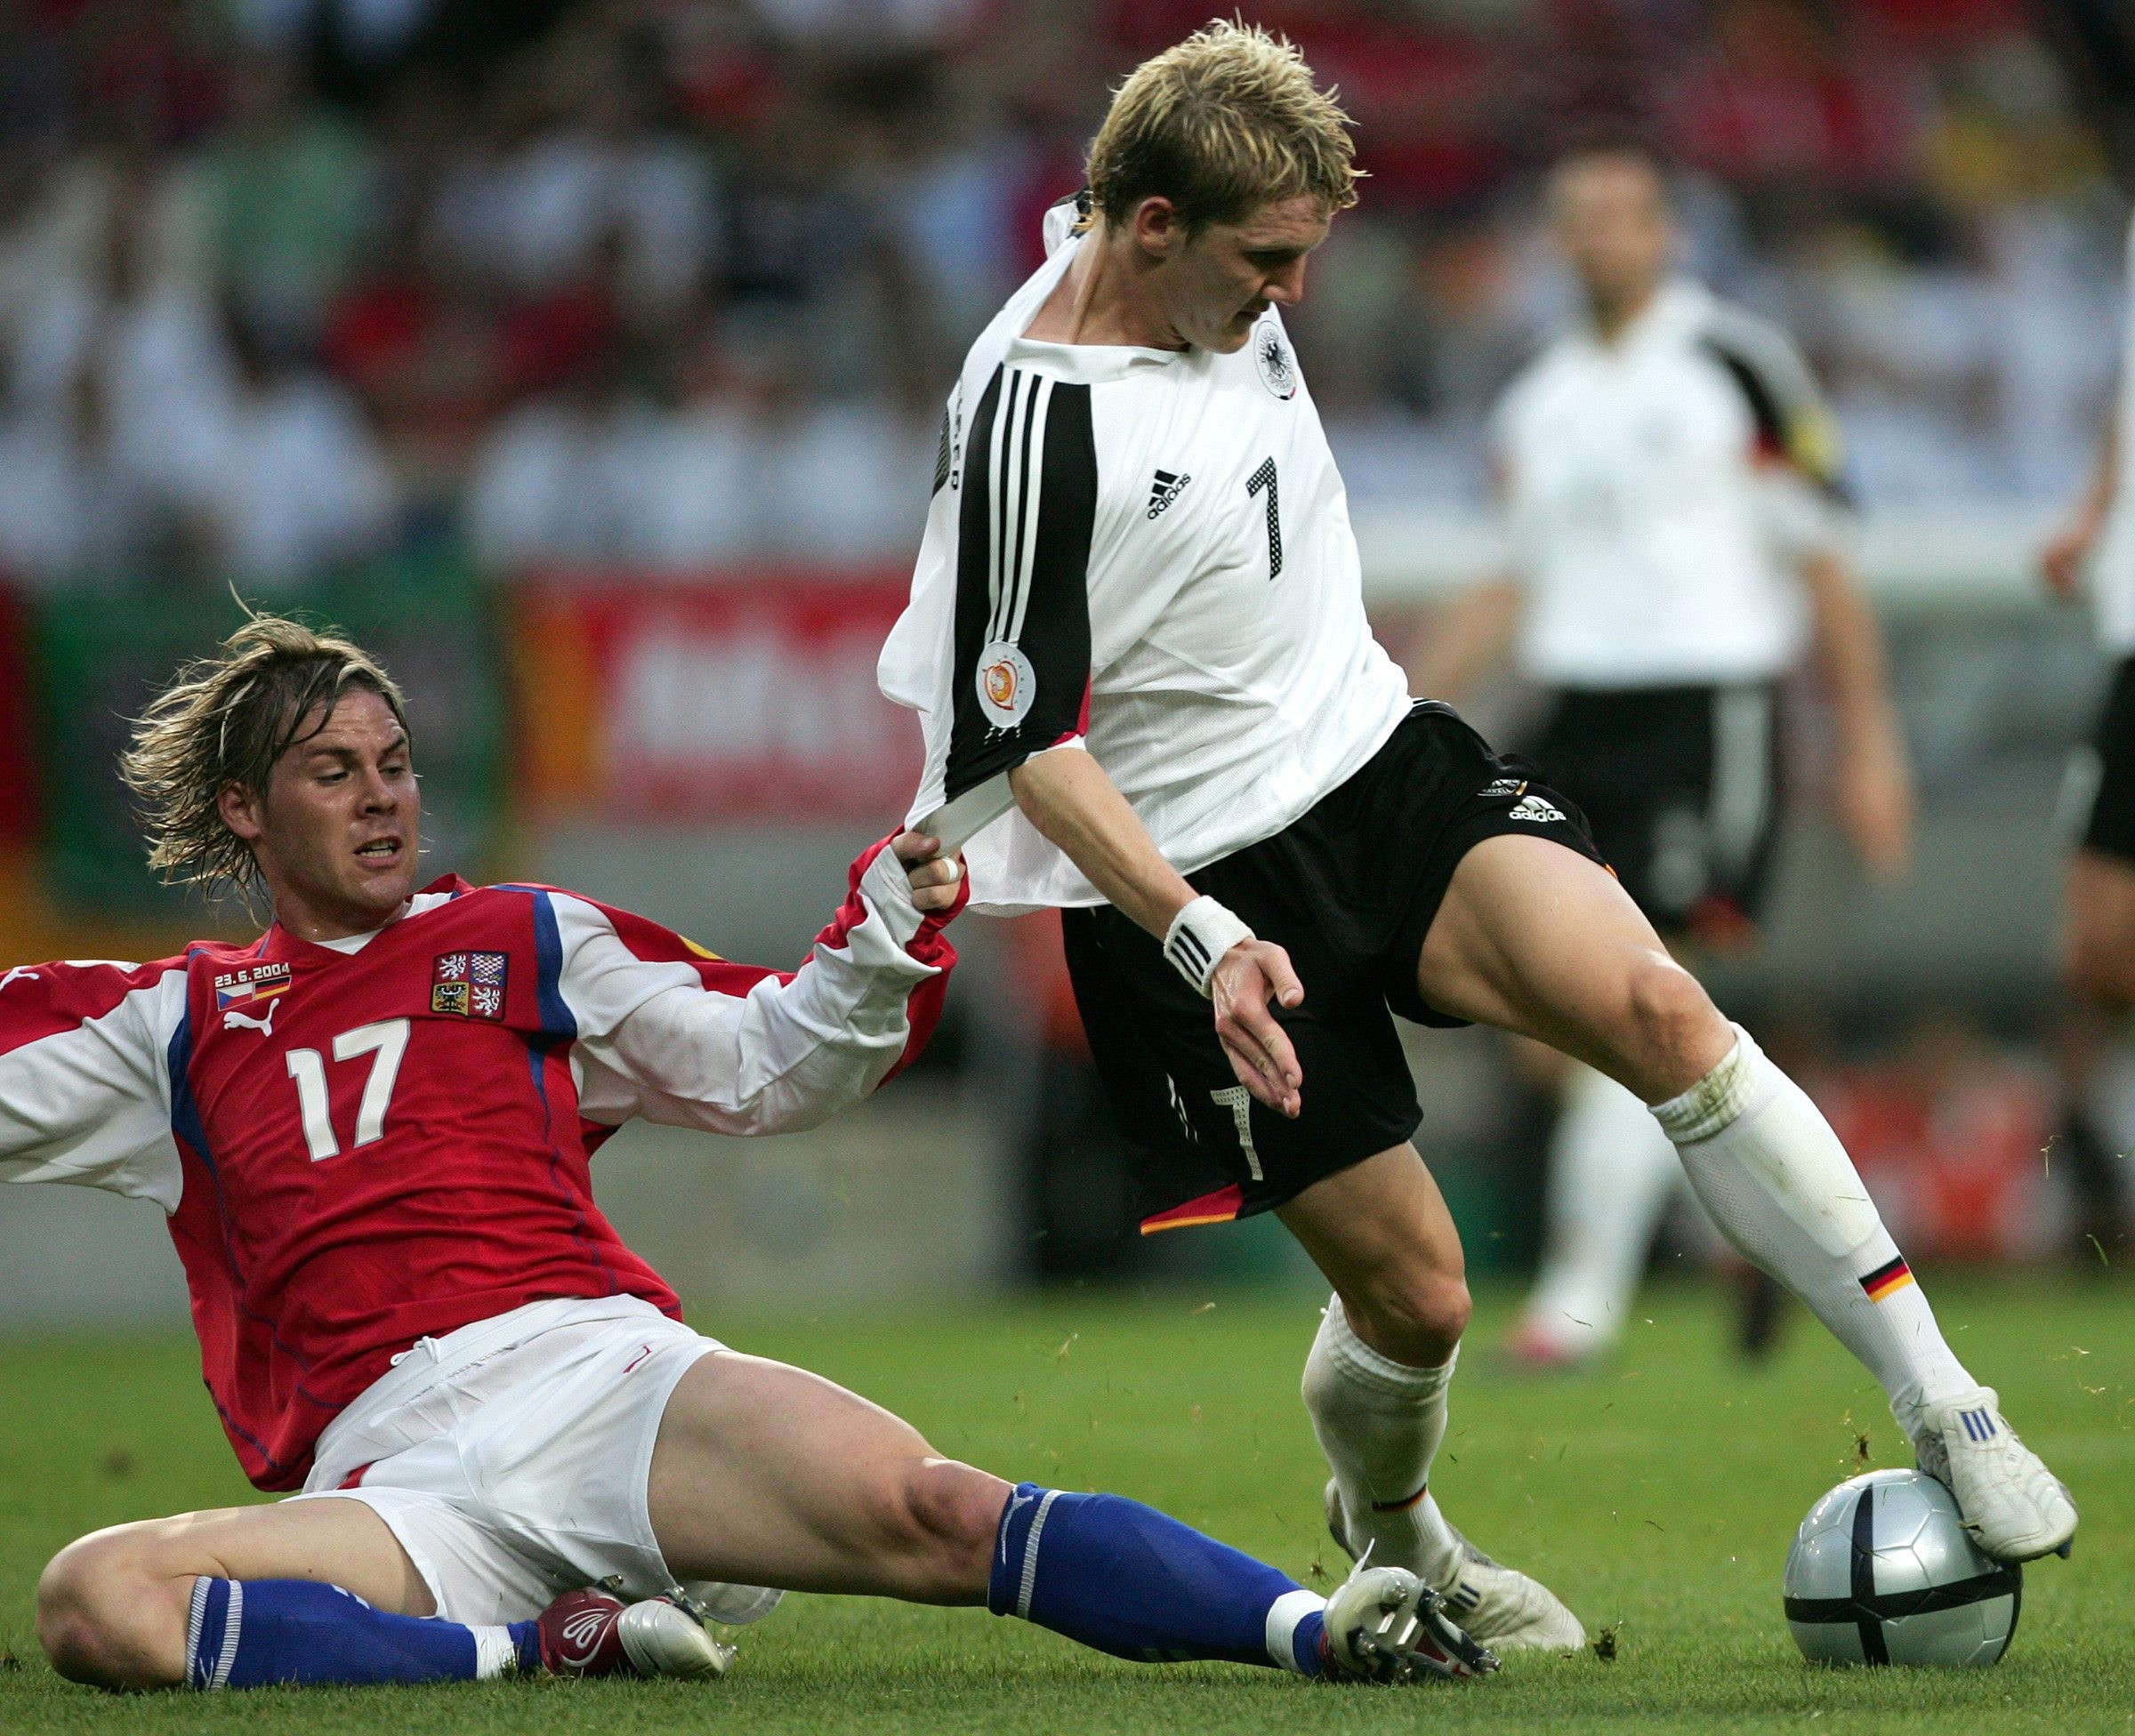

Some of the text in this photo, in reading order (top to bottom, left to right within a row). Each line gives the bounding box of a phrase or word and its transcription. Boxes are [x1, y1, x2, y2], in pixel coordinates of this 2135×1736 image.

[1147, 473, 1191, 520] adidas
[1509, 808, 1567, 823] adidas
[214, 962, 290, 988] 23.6.2004
[286, 1017, 410, 1162] 17
[1210, 1085, 1263, 1181] 7
